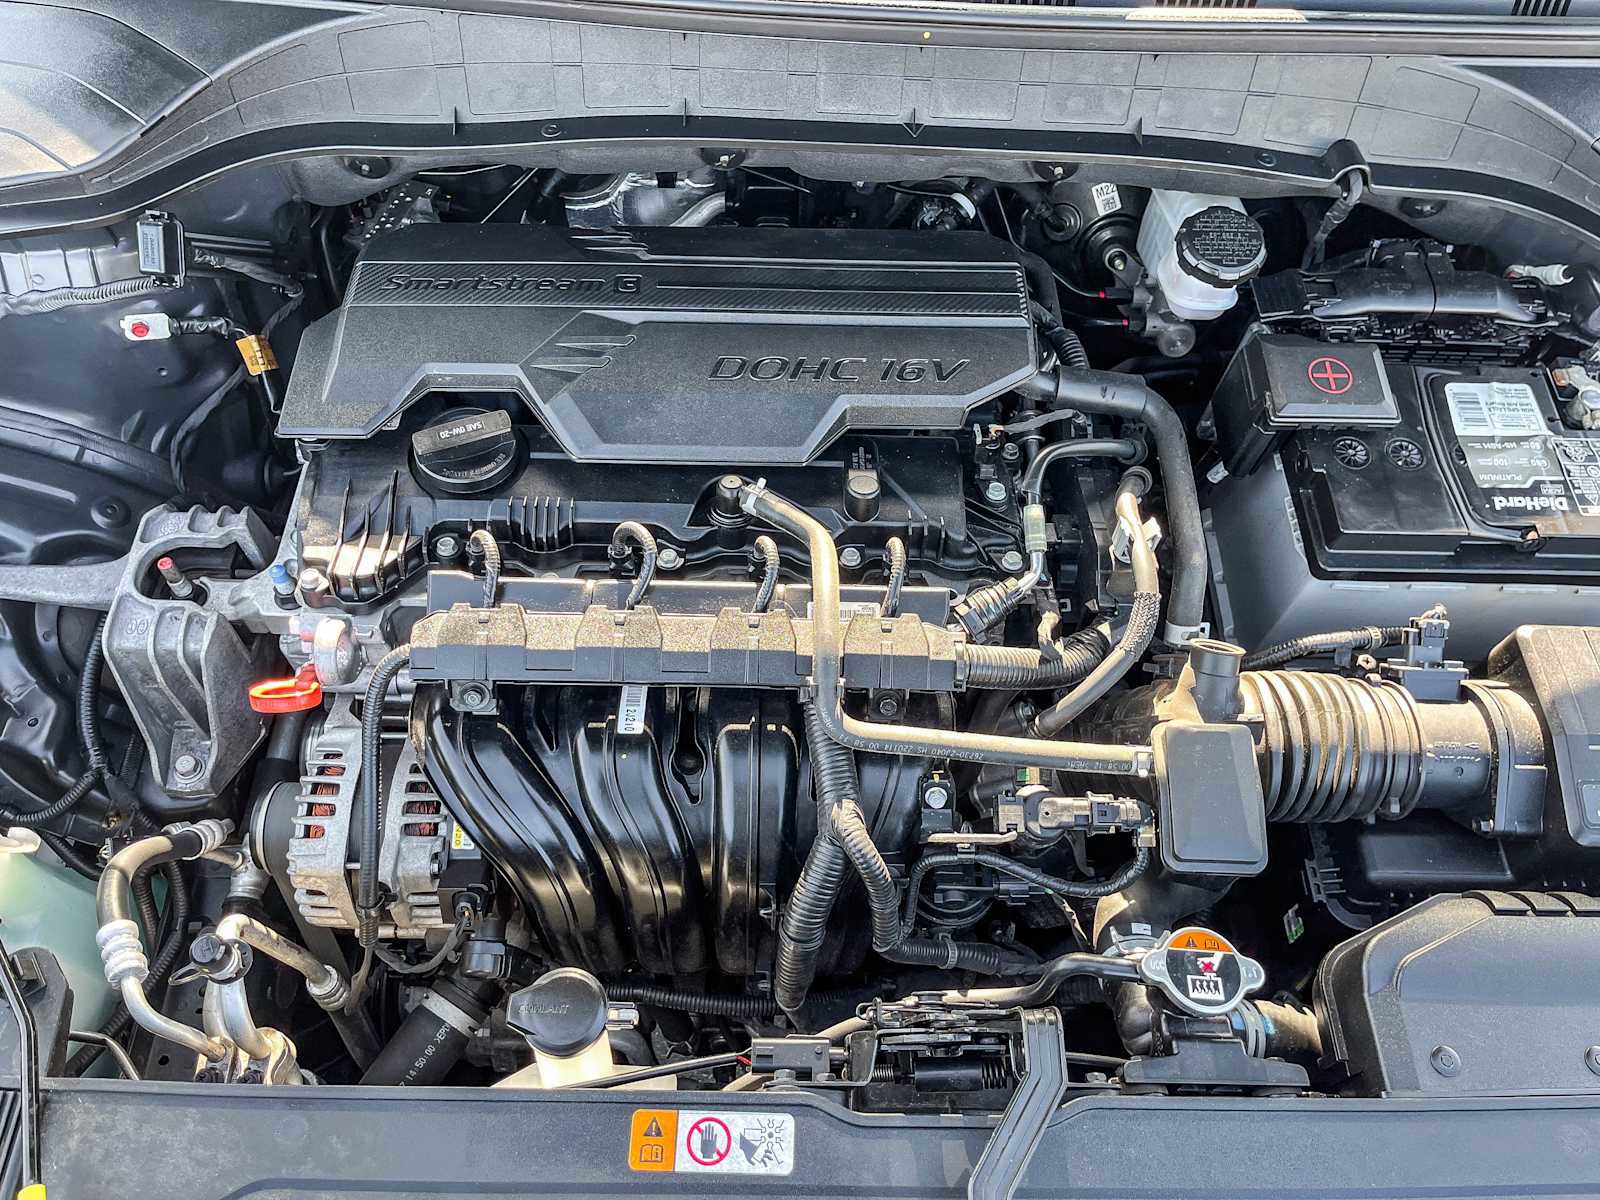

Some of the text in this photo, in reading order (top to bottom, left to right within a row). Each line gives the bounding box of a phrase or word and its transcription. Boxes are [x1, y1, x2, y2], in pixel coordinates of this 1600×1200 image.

[381, 273, 641, 293] Smartstream G
[707, 355, 971, 383] DOHC 16V
[439, 421, 483, 439] SAE 0W-20
[1478, 473, 1522, 481] PLATINUM
[1492, 496, 1569, 511] DieHard
